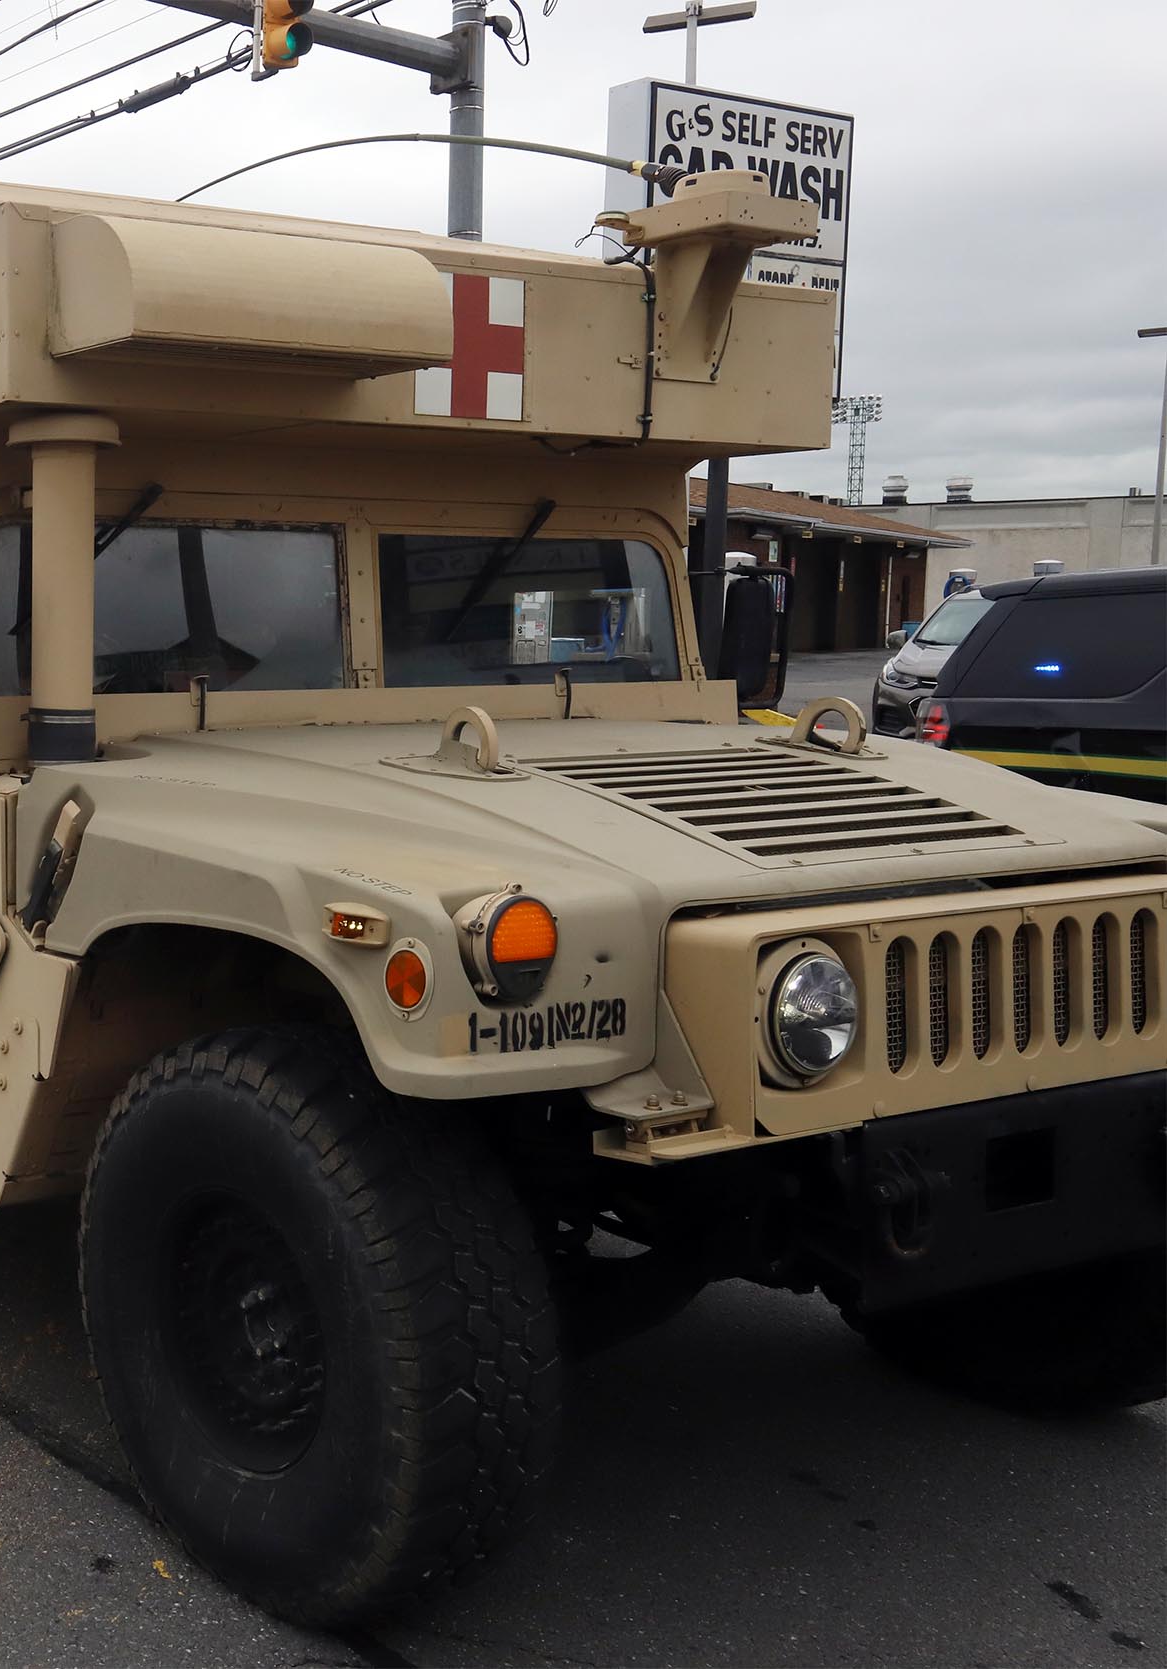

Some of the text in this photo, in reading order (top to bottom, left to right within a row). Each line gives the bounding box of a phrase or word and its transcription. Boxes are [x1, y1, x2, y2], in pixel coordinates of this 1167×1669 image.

[665, 103, 844, 159] G&S SELF SERV
[333, 868, 412, 895] NO STEP
